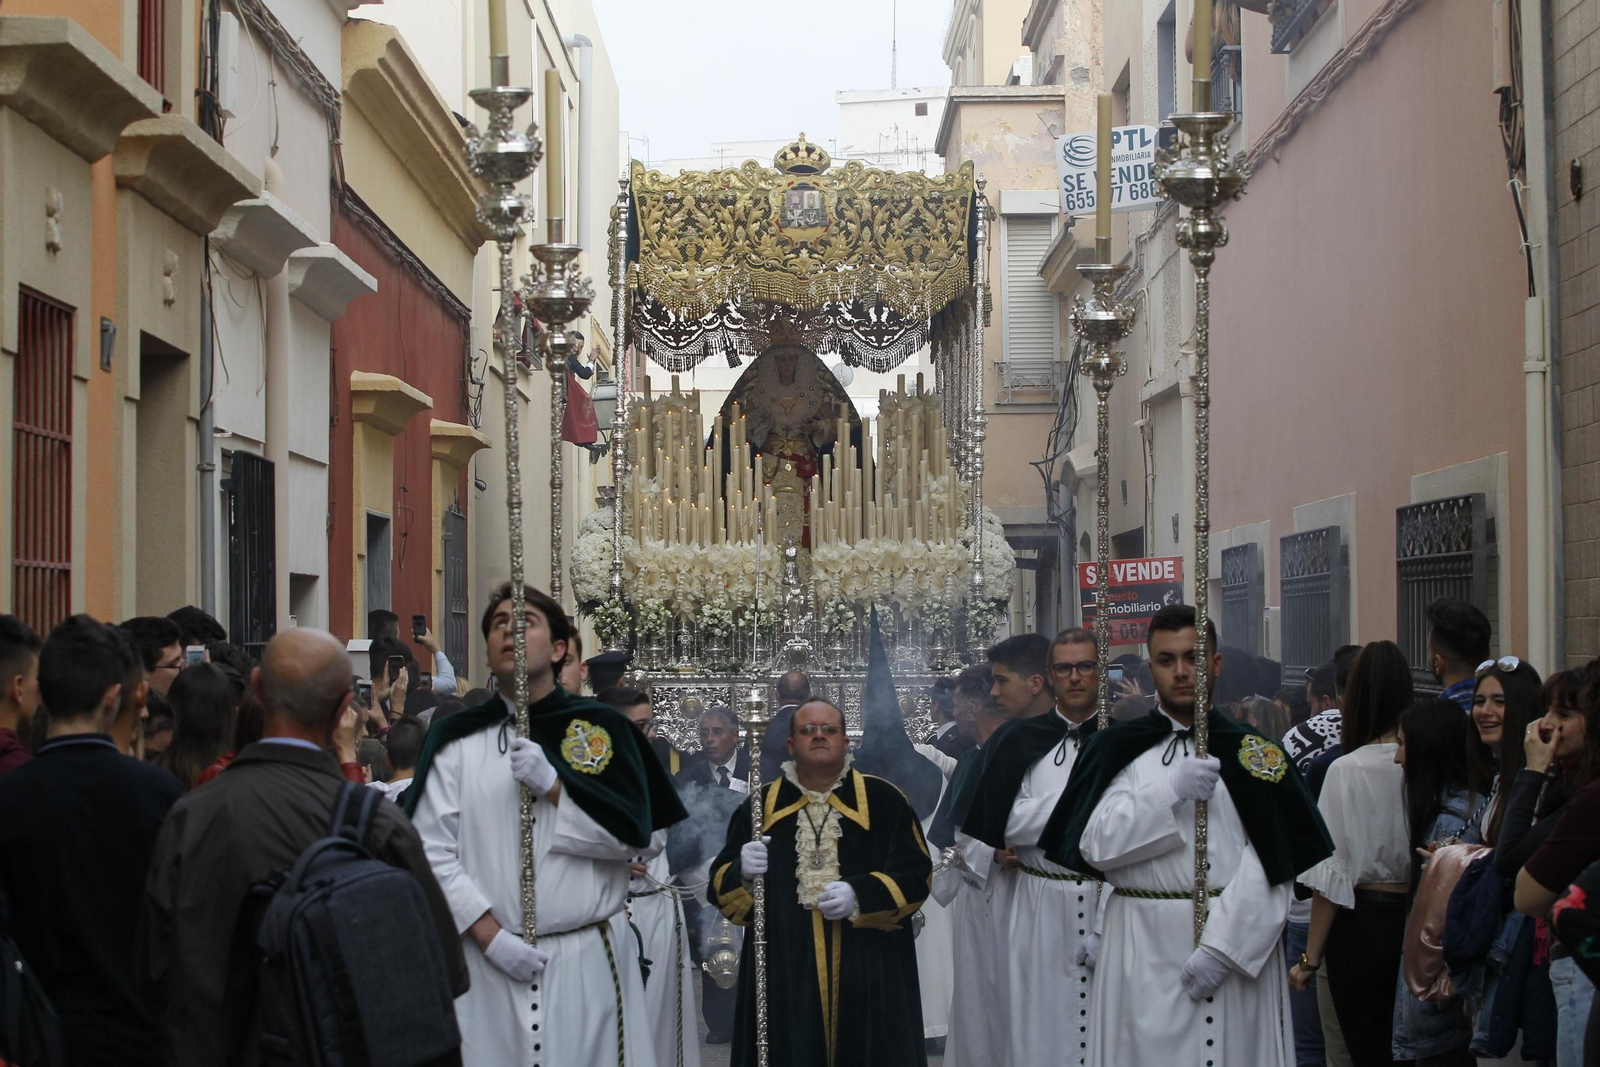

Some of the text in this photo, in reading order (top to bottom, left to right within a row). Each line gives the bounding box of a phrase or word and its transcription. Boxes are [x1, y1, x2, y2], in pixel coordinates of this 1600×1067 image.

[1111, 151, 1151, 163] NMOBILIARIA
[1063, 173, 1087, 193] SE
[1066, 190, 1095, 211] 655
[1113, 560, 1175, 583] VENDE
[1108, 602, 1161, 614] mobiliario
